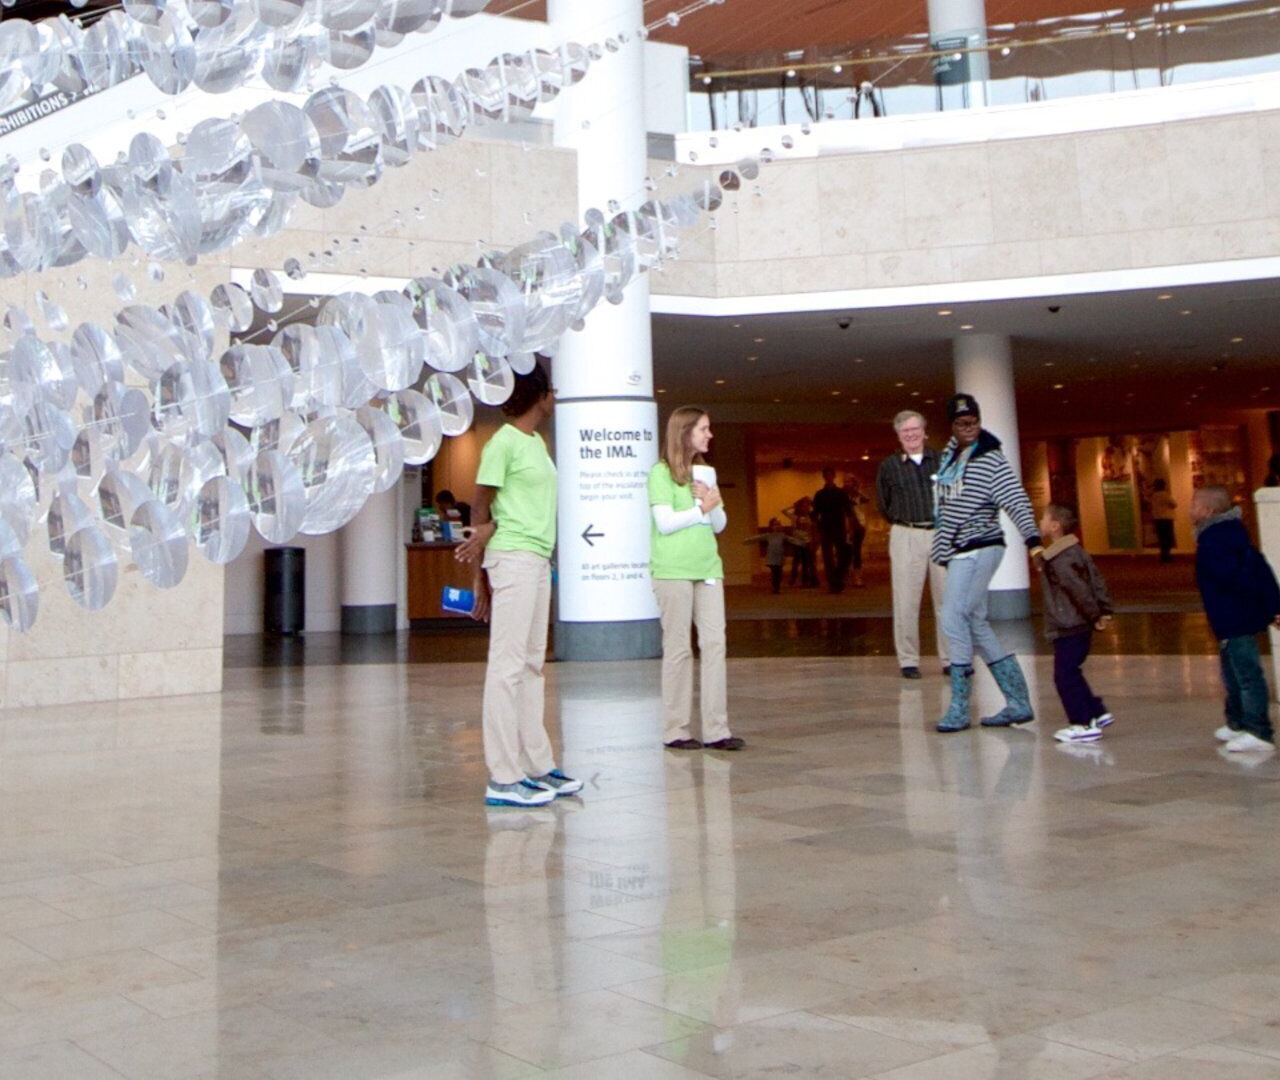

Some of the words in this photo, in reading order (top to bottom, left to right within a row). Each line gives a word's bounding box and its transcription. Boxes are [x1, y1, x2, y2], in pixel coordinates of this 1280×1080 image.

[579, 428, 640, 441] Welcome
[643, 428, 653, 441] to
[579, 445, 602, 459] the
[607, 445, 637, 458] IMA.
